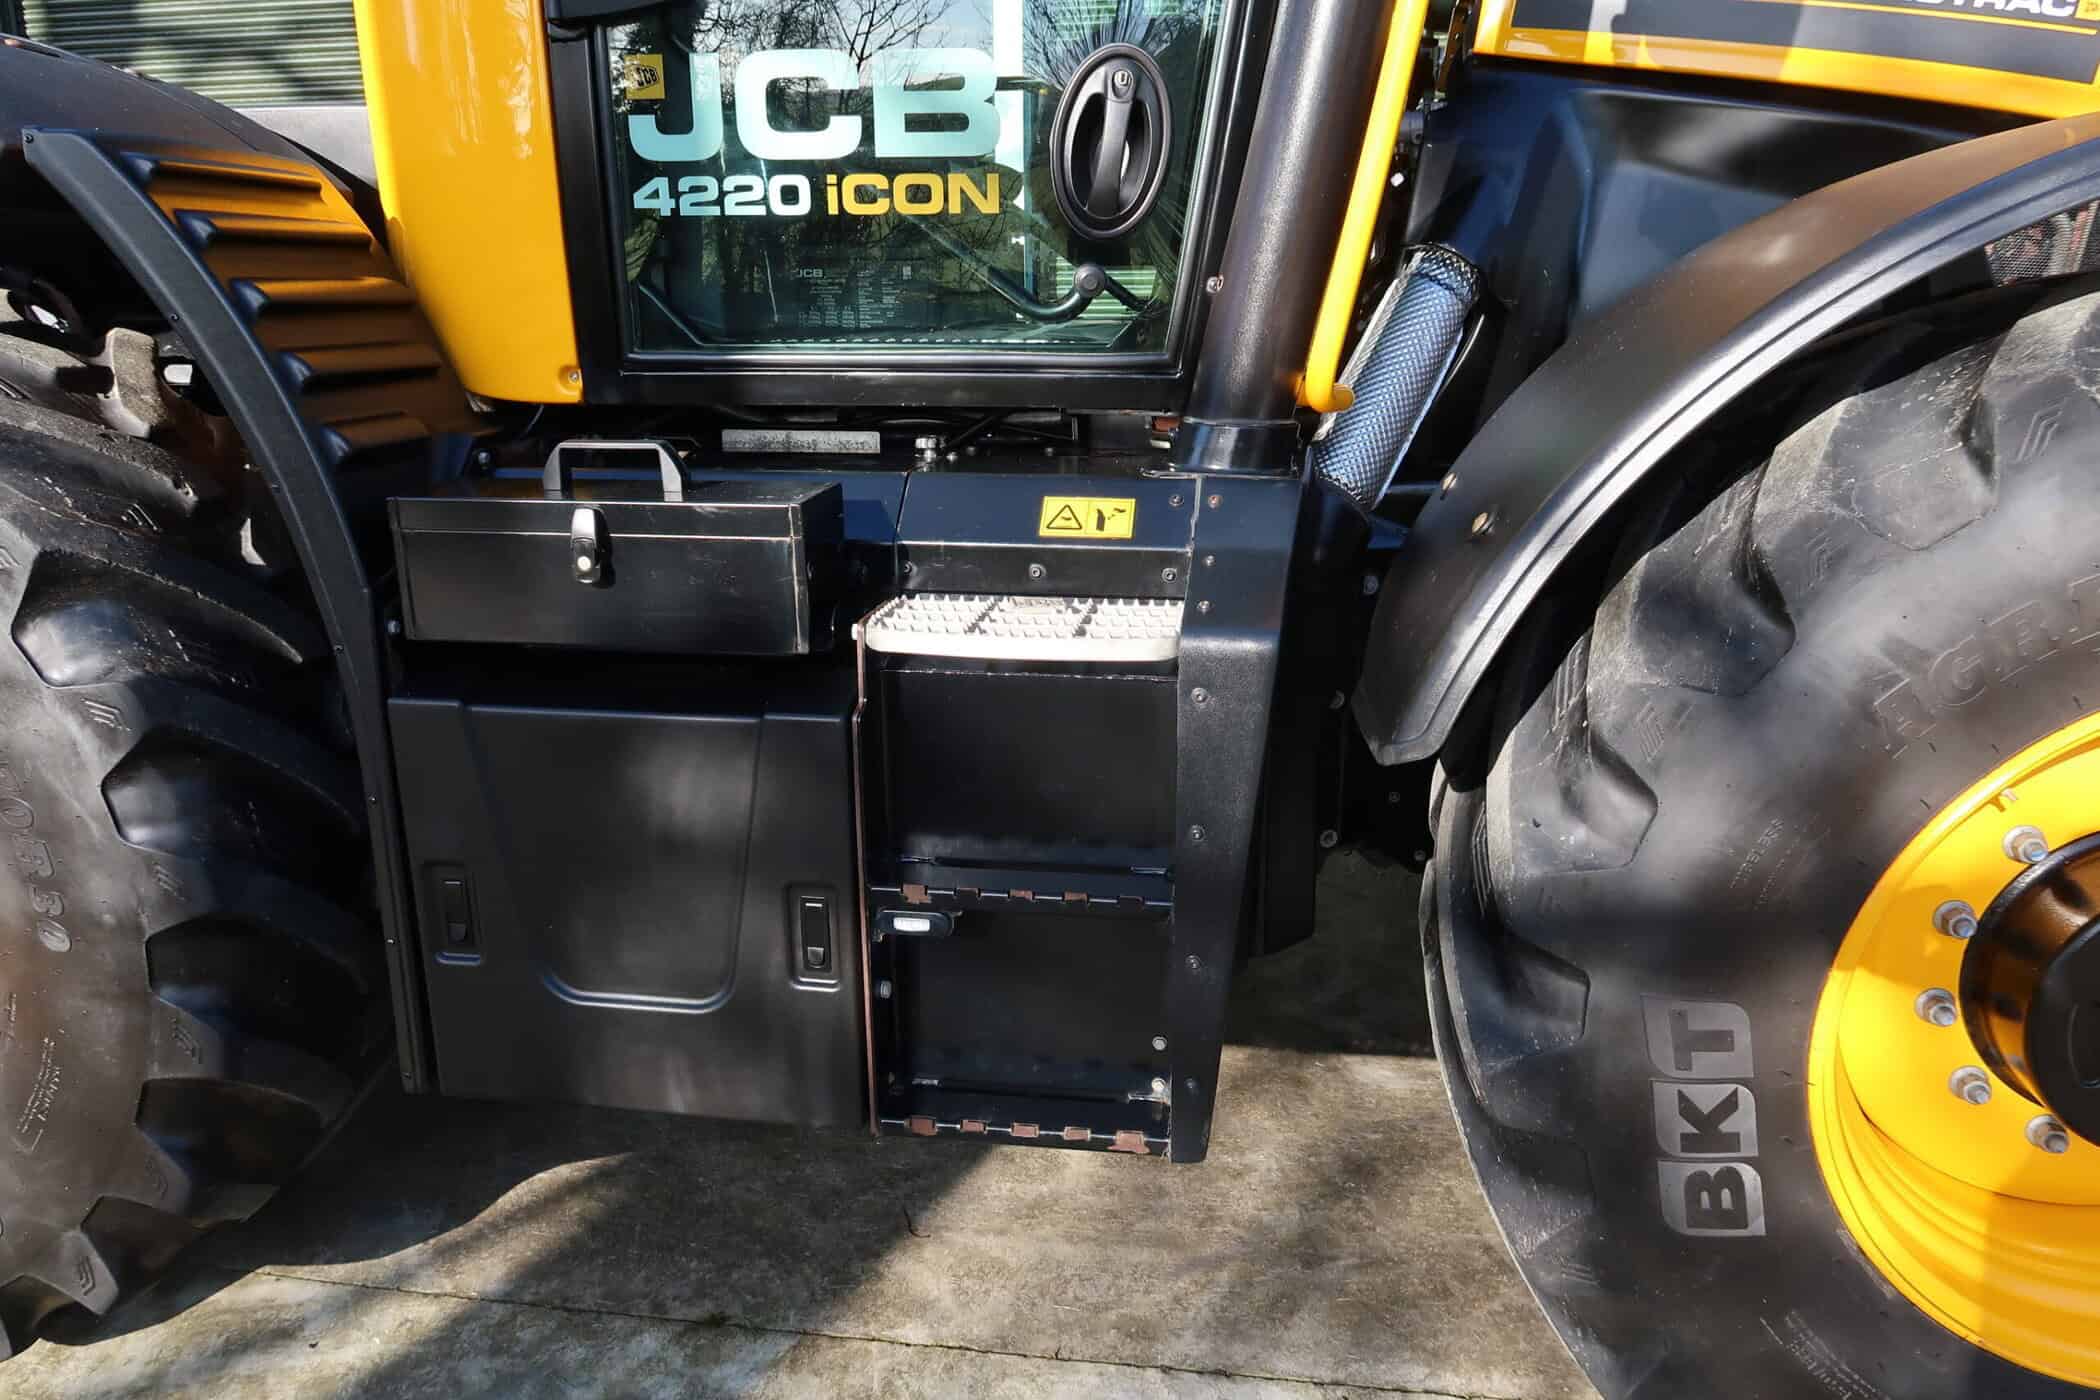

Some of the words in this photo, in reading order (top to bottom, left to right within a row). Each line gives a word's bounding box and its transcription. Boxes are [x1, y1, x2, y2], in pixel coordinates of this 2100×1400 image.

[628, 48, 1000, 162] JCB
[633, 174, 811, 216] 4220
[826, 172, 1000, 216] iCON
[1668, 1007, 1750, 1231] BKT
